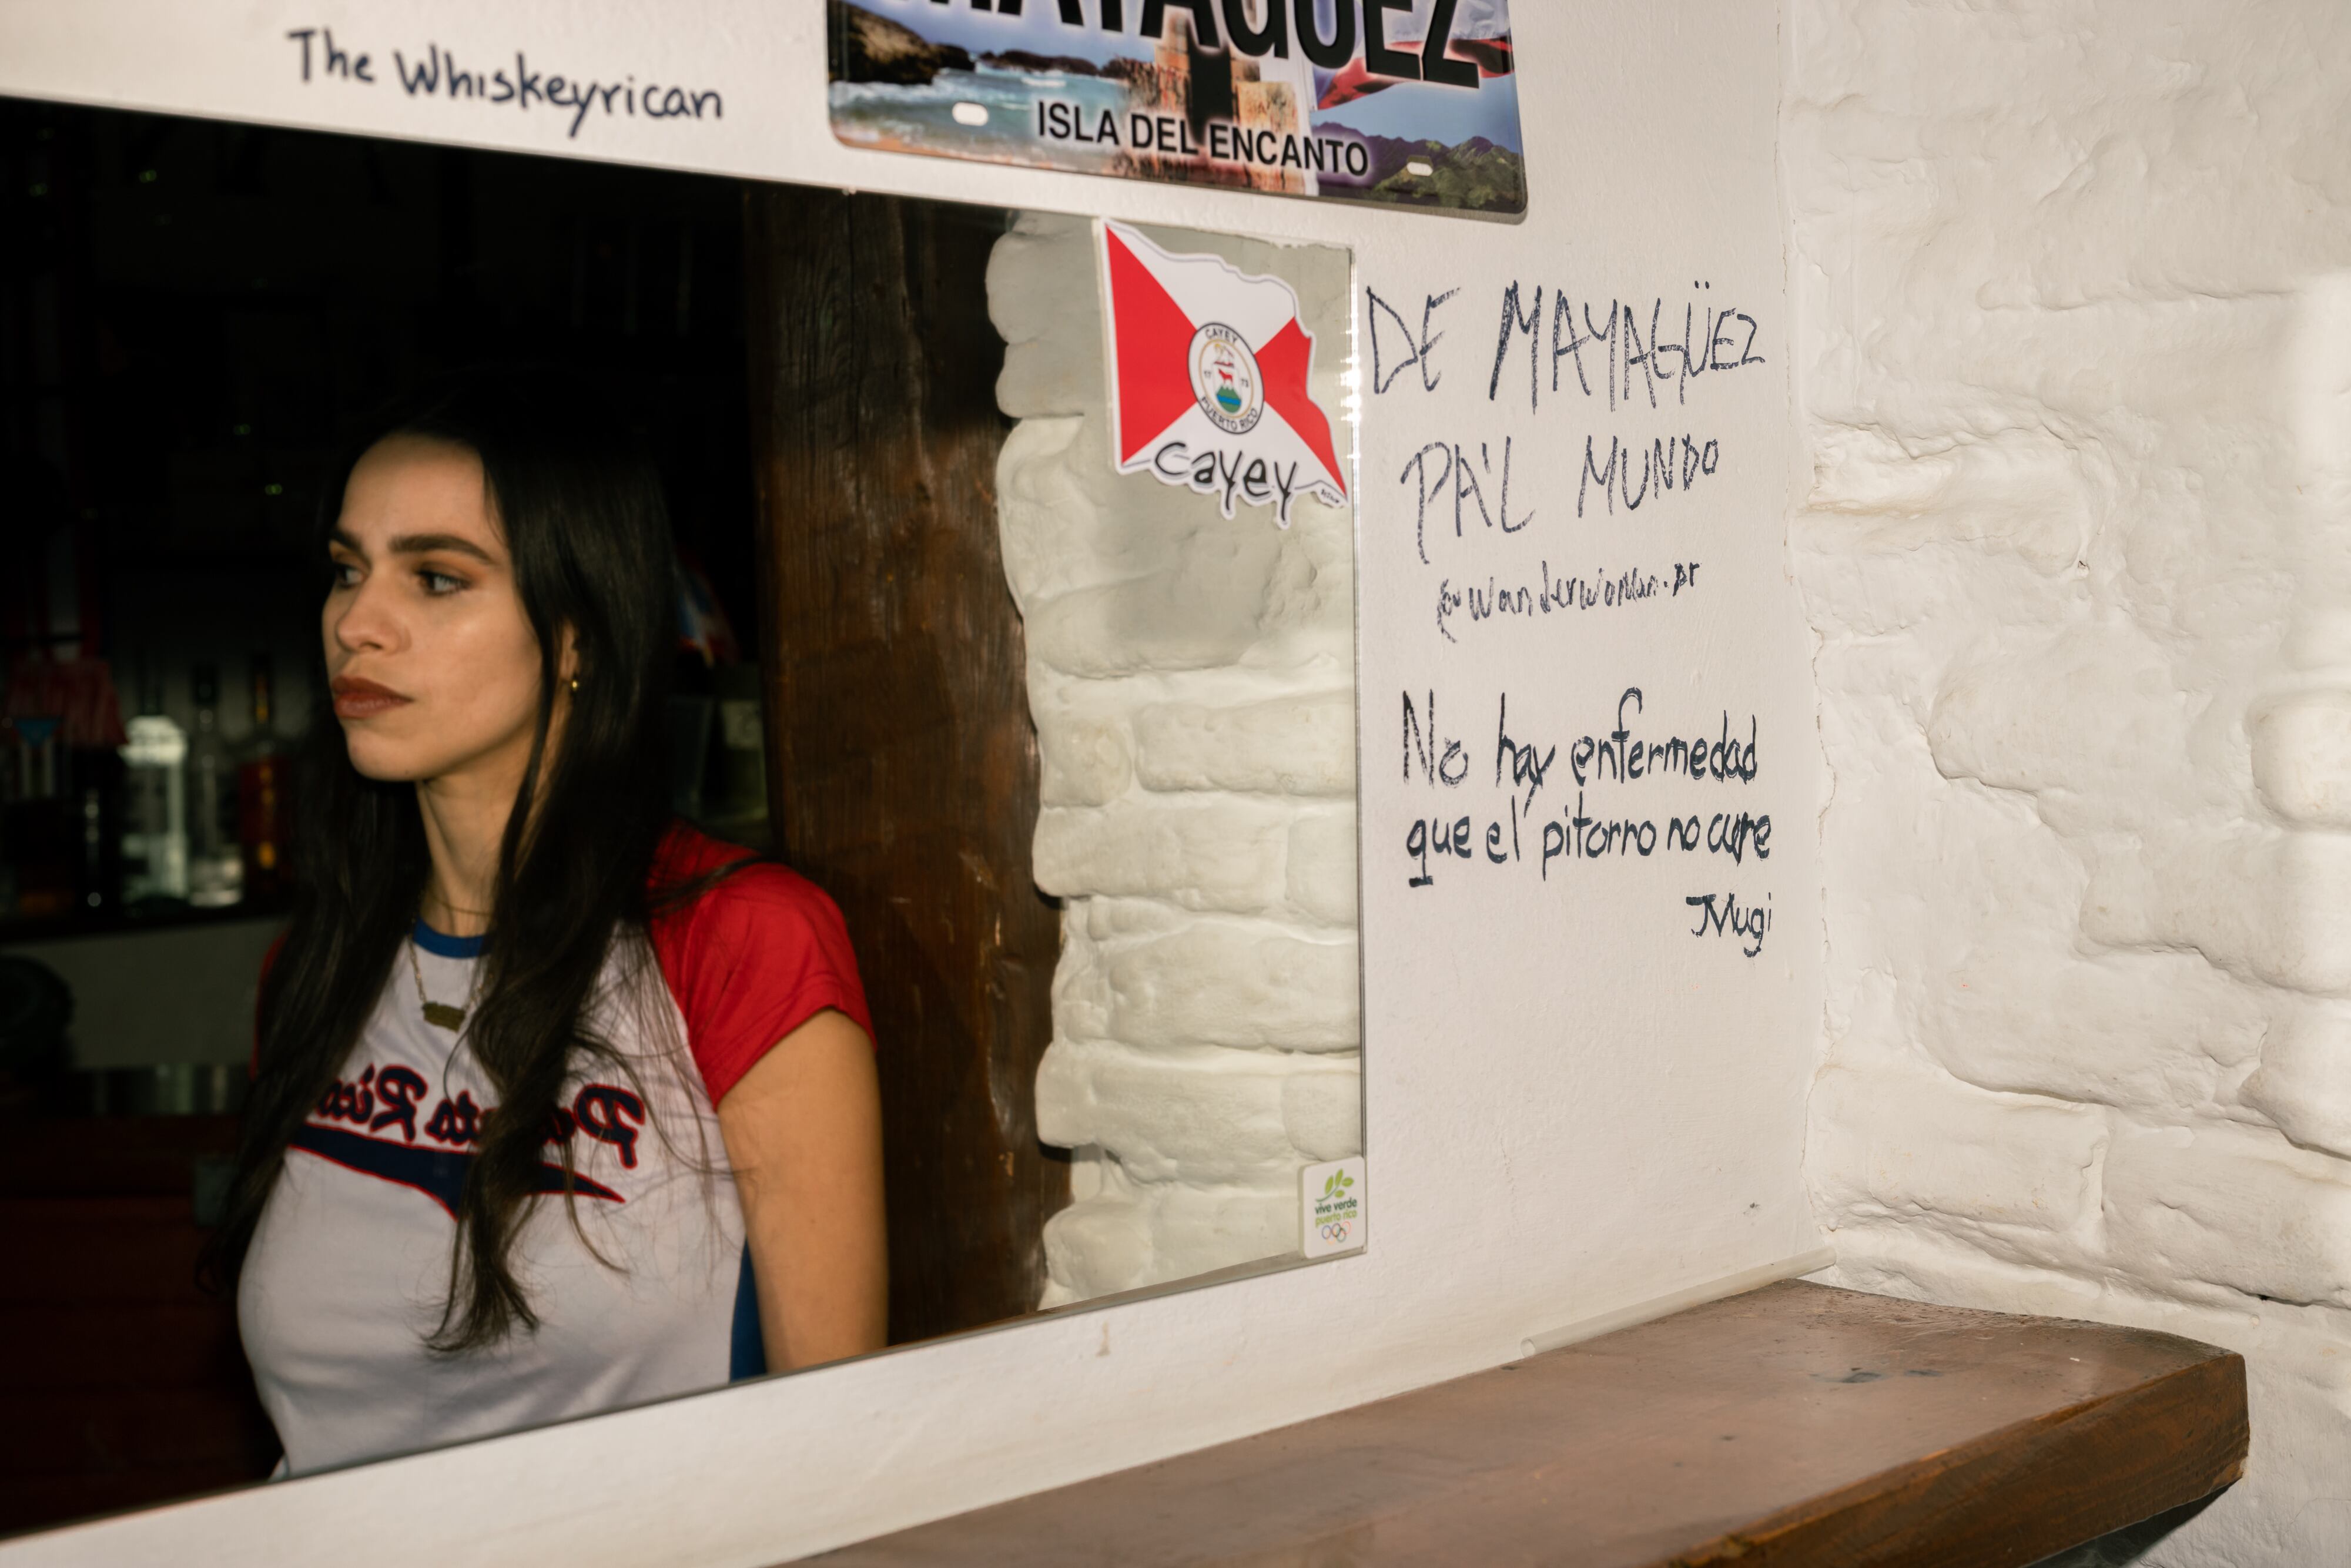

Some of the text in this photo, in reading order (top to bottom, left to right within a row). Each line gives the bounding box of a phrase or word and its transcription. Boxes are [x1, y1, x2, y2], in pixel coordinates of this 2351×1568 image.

[287, 27, 724, 139] The Whiskeyrican
[1037, 100, 1369, 176] ISLA DEL ENCANTO
[1205, 327, 1239, 344] CAYEY
[1365, 280, 1766, 415] DE MAYAGÜEZ
[1201, 396, 1258, 431] PUERTO RICO
[1578, 433, 1719, 518] MUNDO
[1402, 686, 1758, 817] No hay enfermedad
[1406, 790, 1771, 888] que el pitorro no cure
[1315, 1196, 1357, 1214] vive verde
[1315, 1208, 1357, 1228] puerto rico
